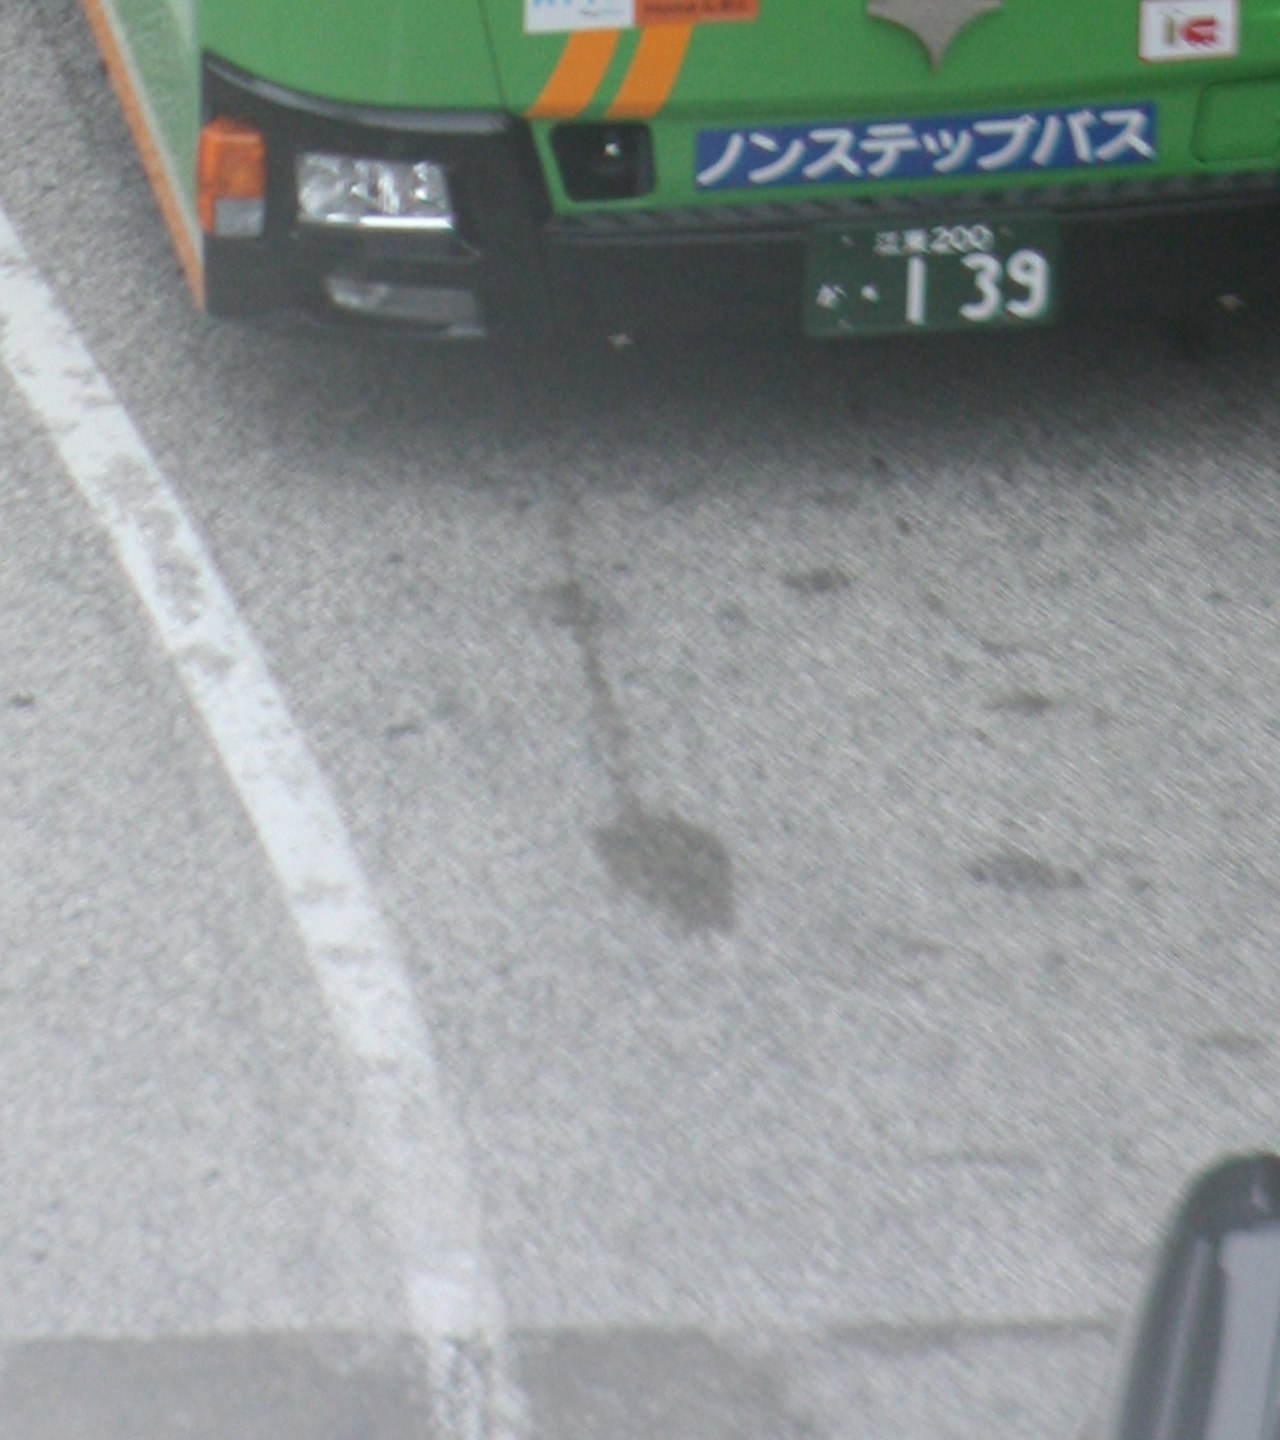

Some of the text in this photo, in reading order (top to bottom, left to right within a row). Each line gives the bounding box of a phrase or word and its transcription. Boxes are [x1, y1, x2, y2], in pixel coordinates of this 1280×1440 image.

[697, 108, 1156, 186] ノンステップバス
